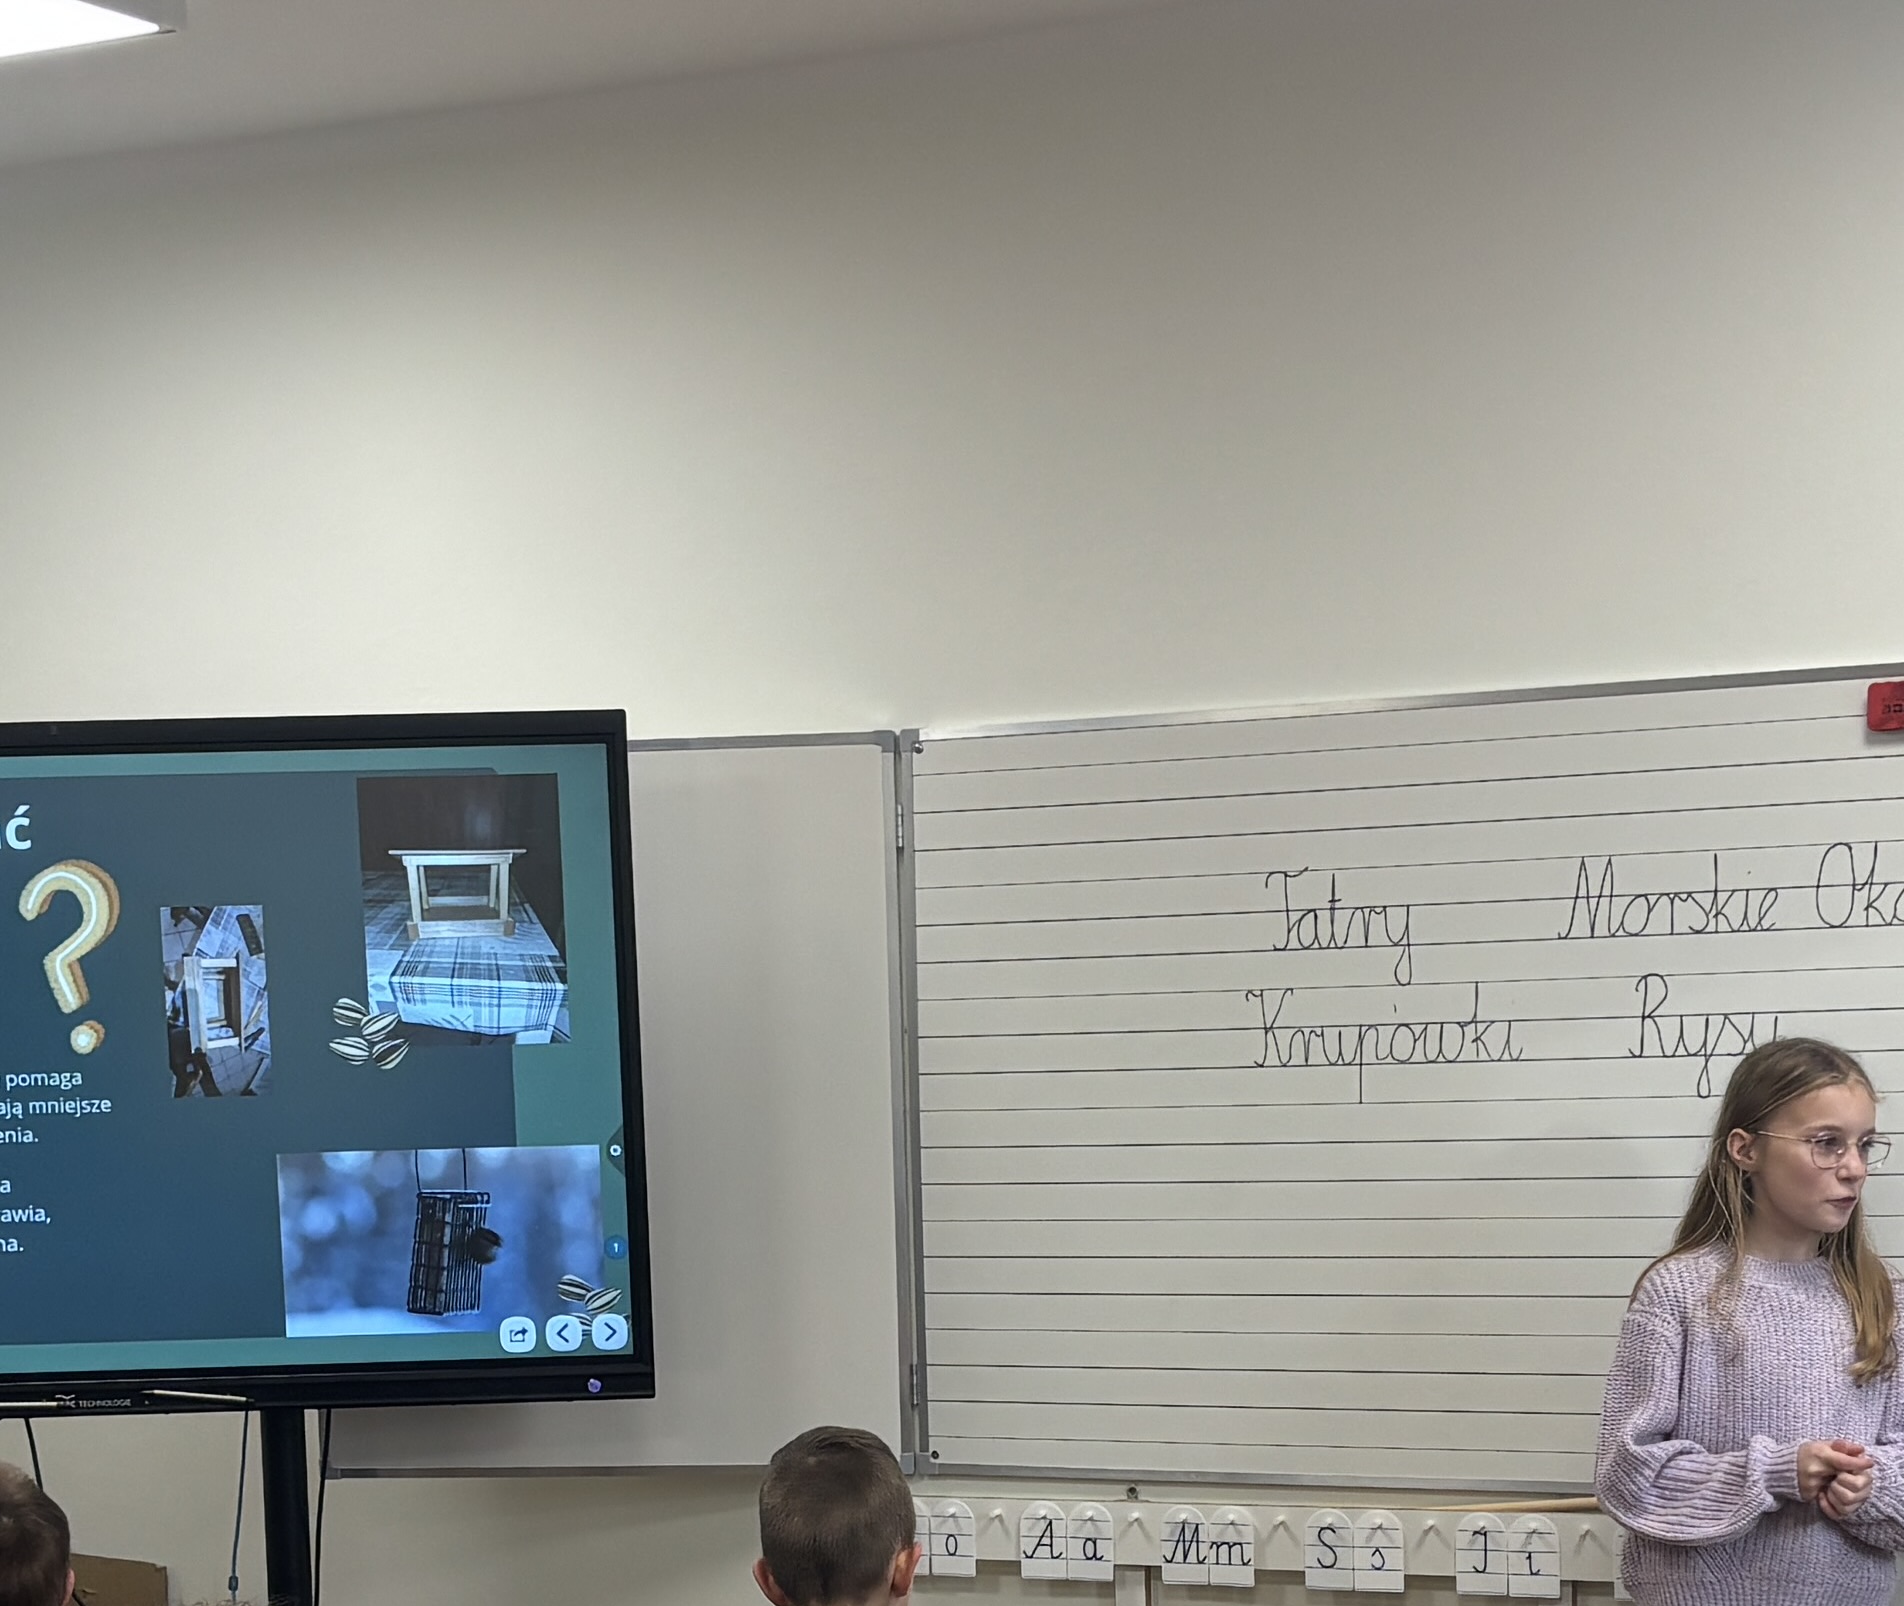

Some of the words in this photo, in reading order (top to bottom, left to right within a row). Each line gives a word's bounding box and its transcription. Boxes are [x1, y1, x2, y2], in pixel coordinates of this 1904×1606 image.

[1265, 867, 1414, 986] Tatry
[1558, 854, 1781, 939] Morskie
[6, 1070, 82, 1090] pomaga
[29, 1096, 111, 1117] mniejsze
[1023, 1519, 1063, 1559] A
[1083, 1538, 1104, 1561] a
[1163, 1524, 1207, 1564] M
[1210, 1542, 1251, 1565] m
[1317, 1527, 1337, 1568] S
